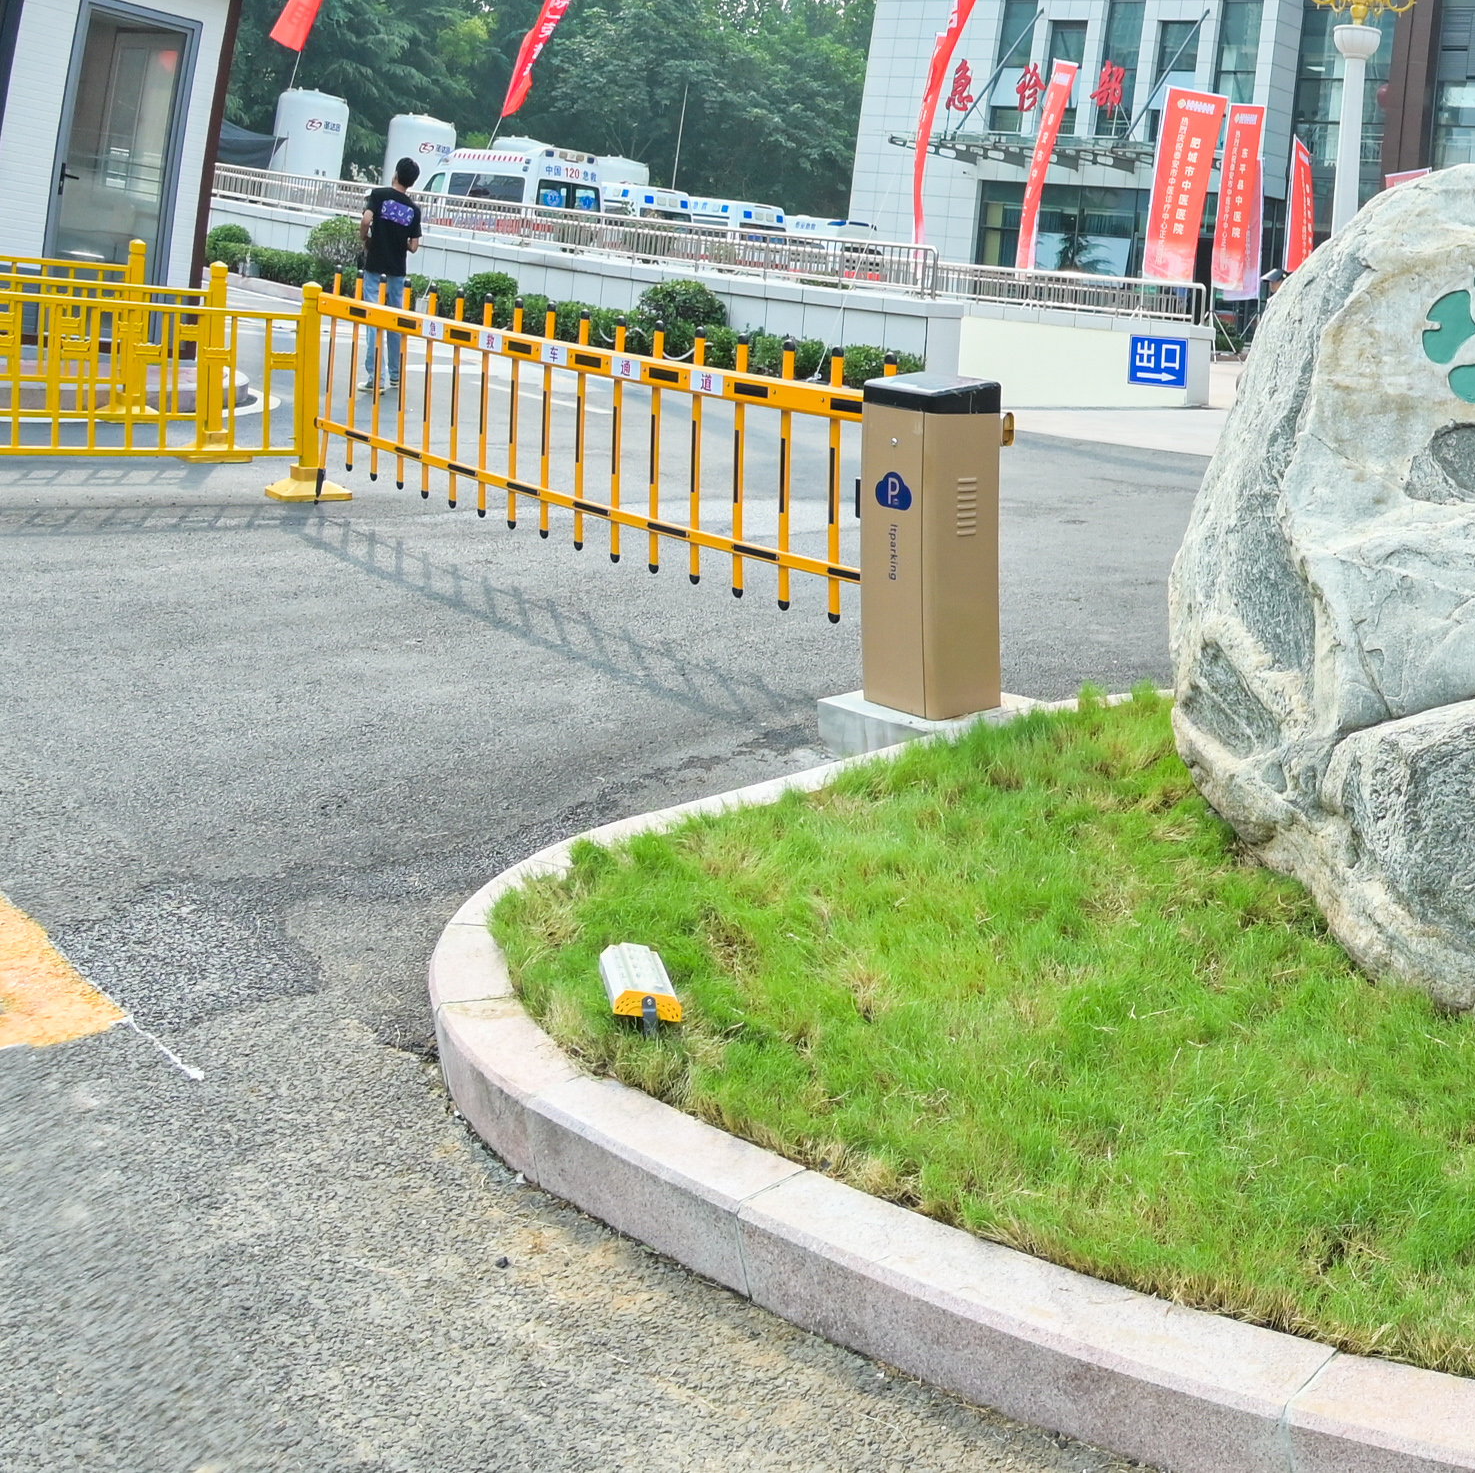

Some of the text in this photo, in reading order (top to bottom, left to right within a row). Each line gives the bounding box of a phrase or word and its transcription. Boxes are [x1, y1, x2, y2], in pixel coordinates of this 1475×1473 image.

[946, 59, 1126, 119] 急诊部
[545, 164, 597, 183] 中国 120 急救
[1172, 137, 1203, 236] 肥城市中医医院
[1231, 147, 1249, 239] 东平县中医院
[428, 321, 714, 392] 急救车通道
[1135, 340, 1182, 371] 出口
[887, 476, 900, 505] P
